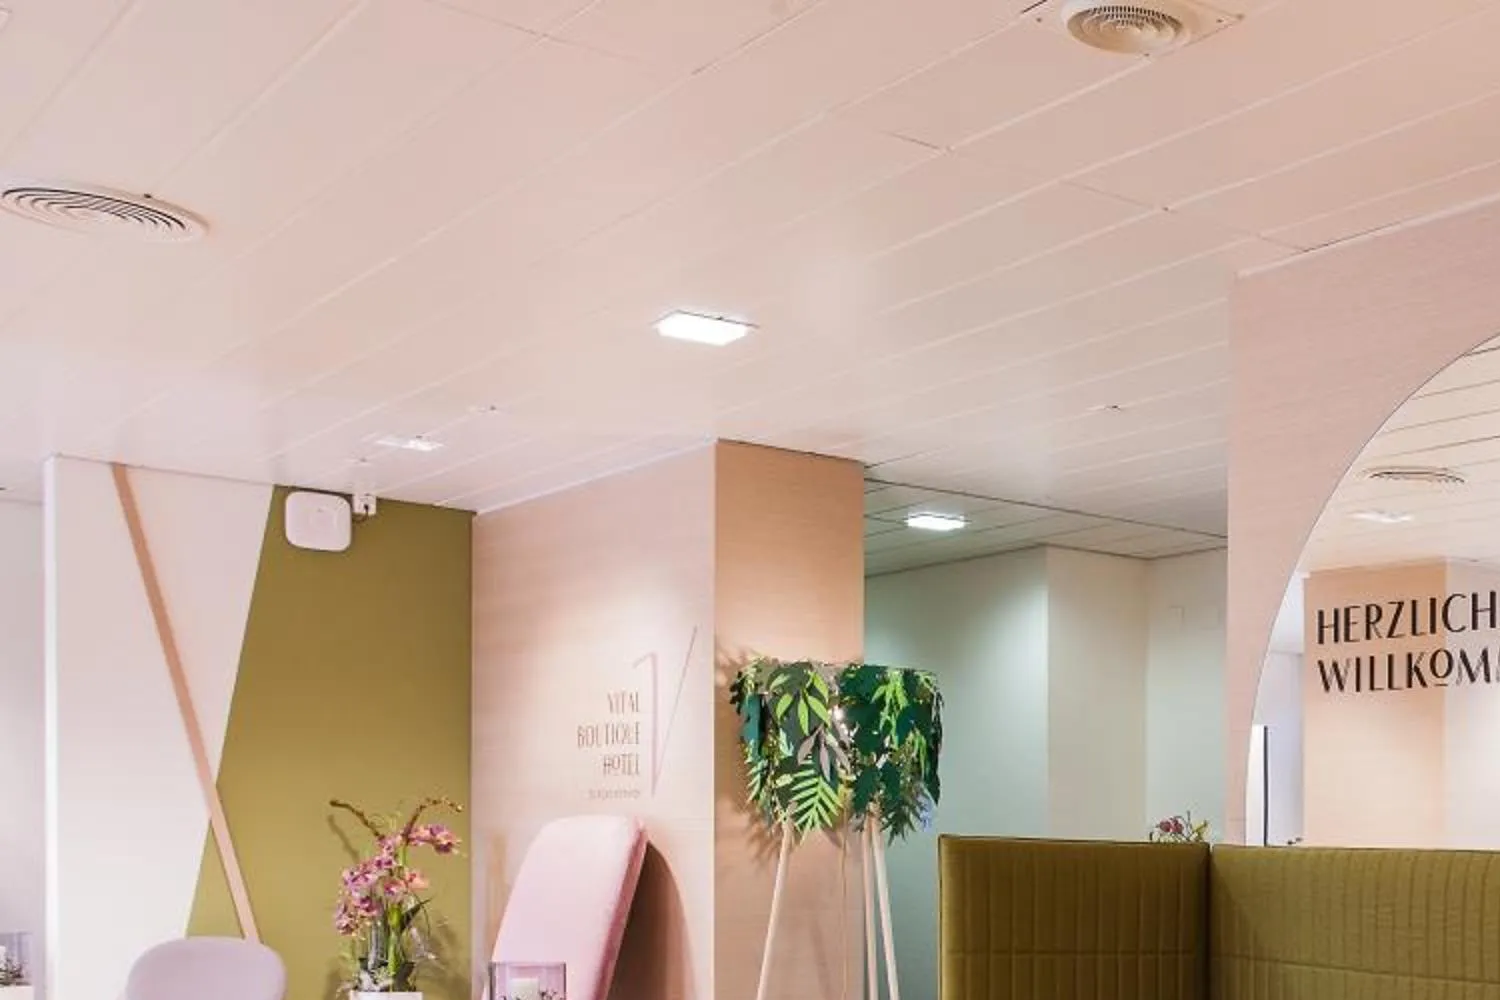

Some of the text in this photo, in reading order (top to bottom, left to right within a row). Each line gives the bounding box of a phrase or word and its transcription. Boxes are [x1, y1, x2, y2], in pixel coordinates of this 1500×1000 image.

[1316, 590, 1498, 645] HERZLICH
[606, 690, 641, 715] VITAL
[576, 721, 641, 749] BOUTIQUE
[602, 752, 641, 777] HOTEL
